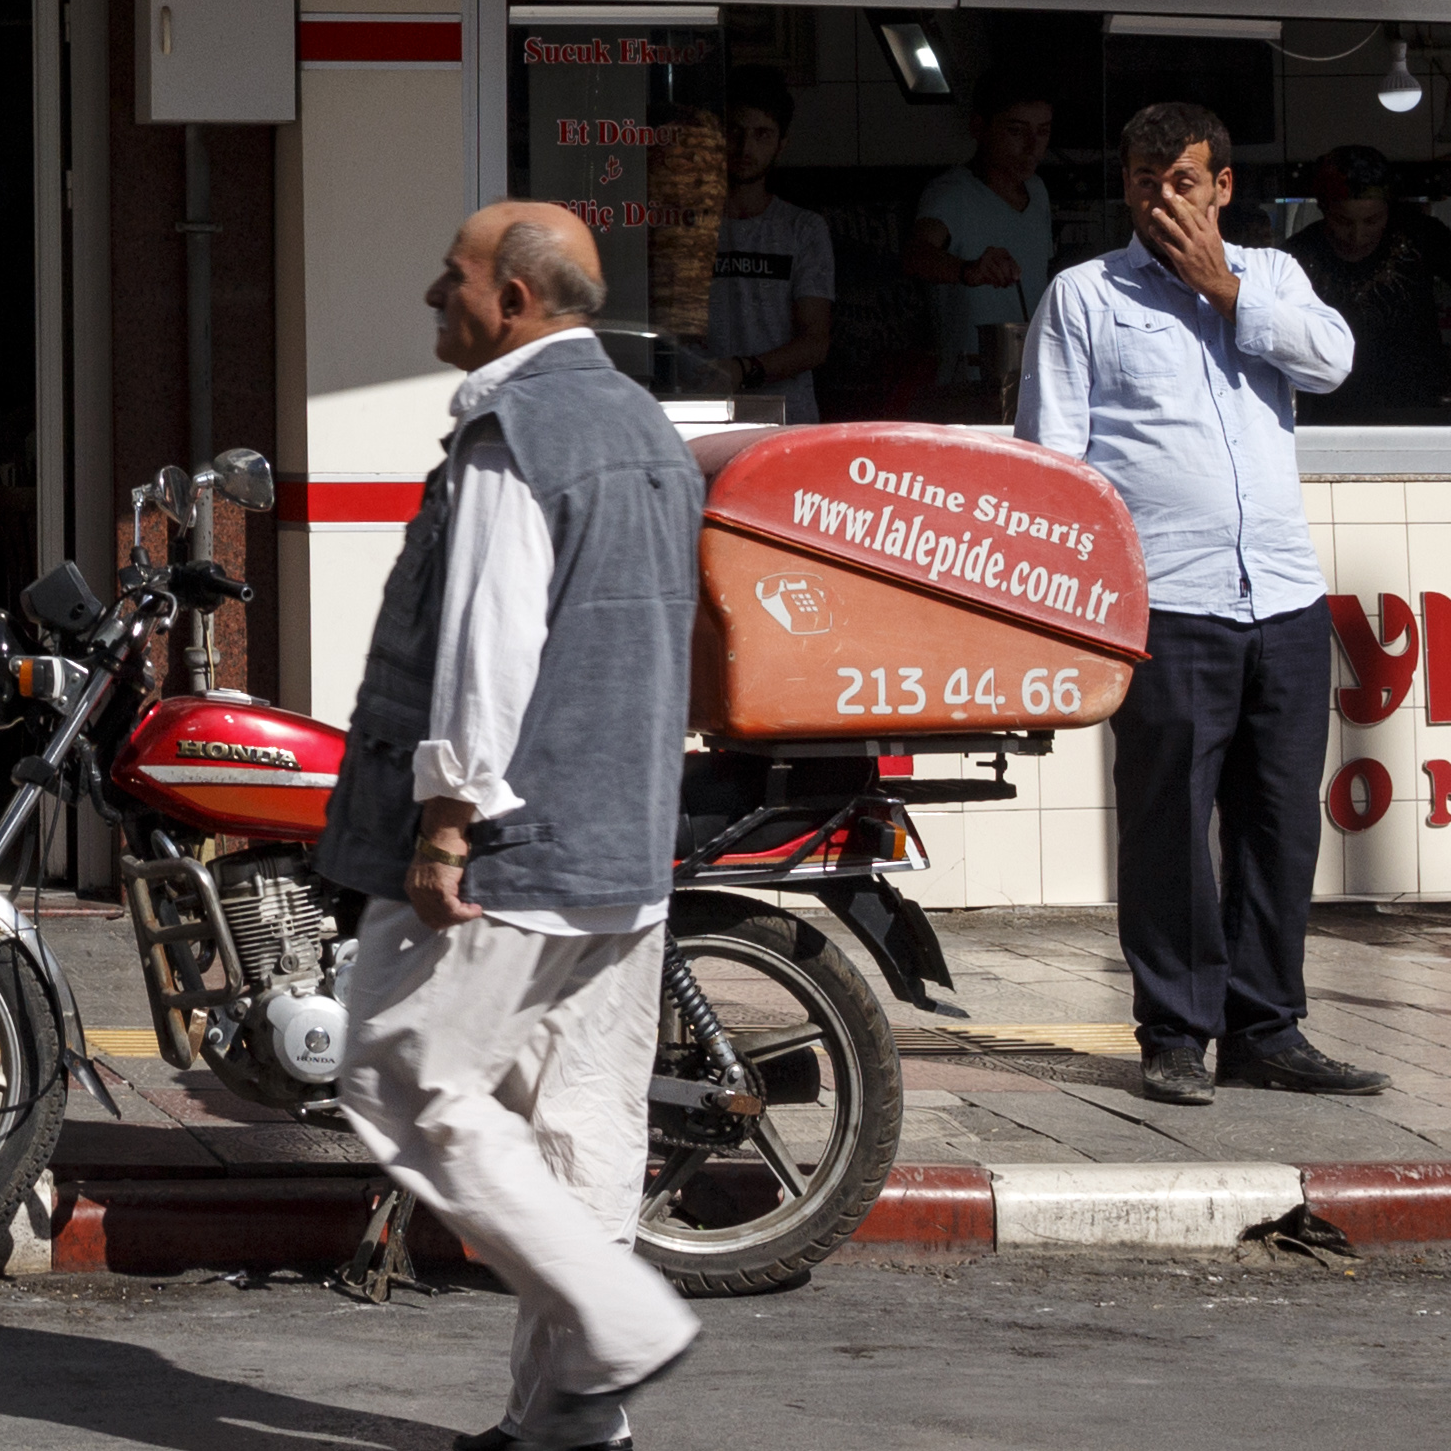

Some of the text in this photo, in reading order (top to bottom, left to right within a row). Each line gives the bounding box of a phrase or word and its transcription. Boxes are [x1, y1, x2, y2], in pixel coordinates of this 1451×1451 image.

[524, 37, 612, 64] Sucuk
[557, 118, 683, 145] Et Döner
[849, 456, 1095, 561] Online Sipariş
[793, 488, 1119, 627] www.lalepide.com.tr
[836, 667, 927, 715] 213
[1022, 668, 1082, 715] 66
[176, 739, 302, 771] HONDA
[295, 1055, 338, 1066] HONDA
